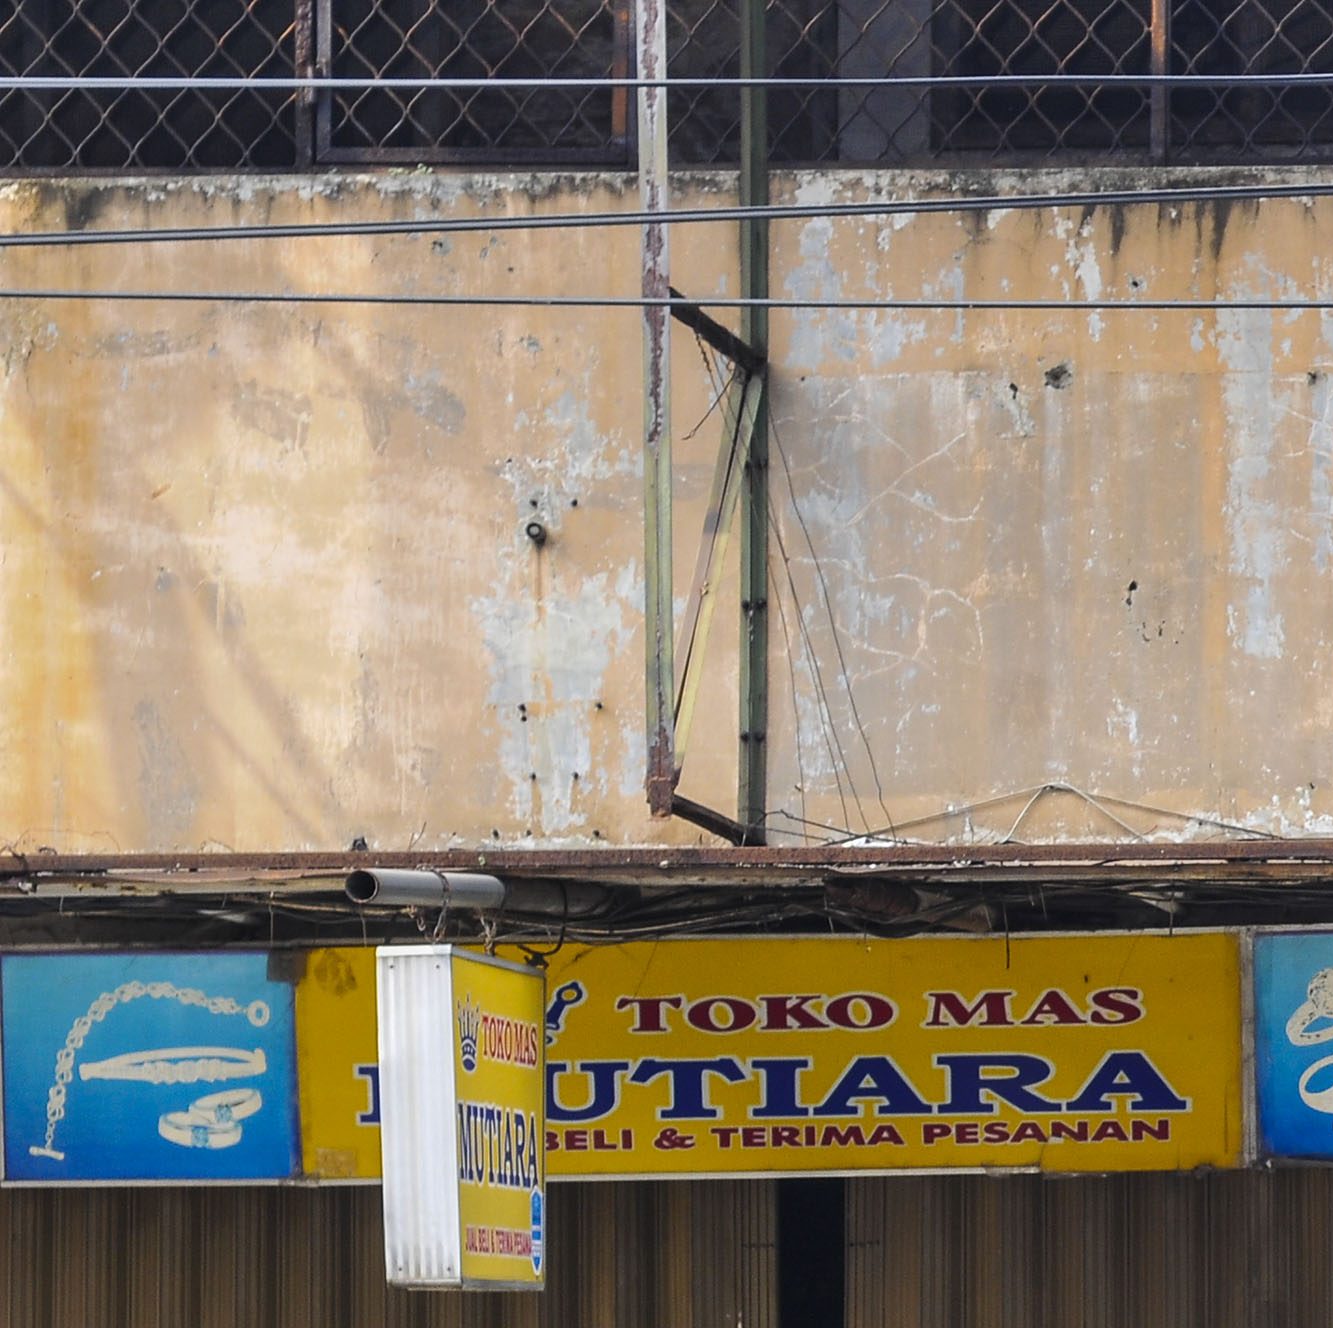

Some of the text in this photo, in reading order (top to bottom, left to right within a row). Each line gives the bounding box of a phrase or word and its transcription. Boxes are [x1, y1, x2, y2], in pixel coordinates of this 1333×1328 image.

[617, 989, 1143, 1033] TOKO MAS
[482, 1013, 538, 1067] TOKO MAS
[358, 1052, 1192, 1123] UTIARA
[457, 1101, 539, 1189] MUTIARA
[654, 1127, 695, 1150] &
[711, 1124, 905, 1149] TERIMA
[923, 1119, 1171, 1145] PESANAN
